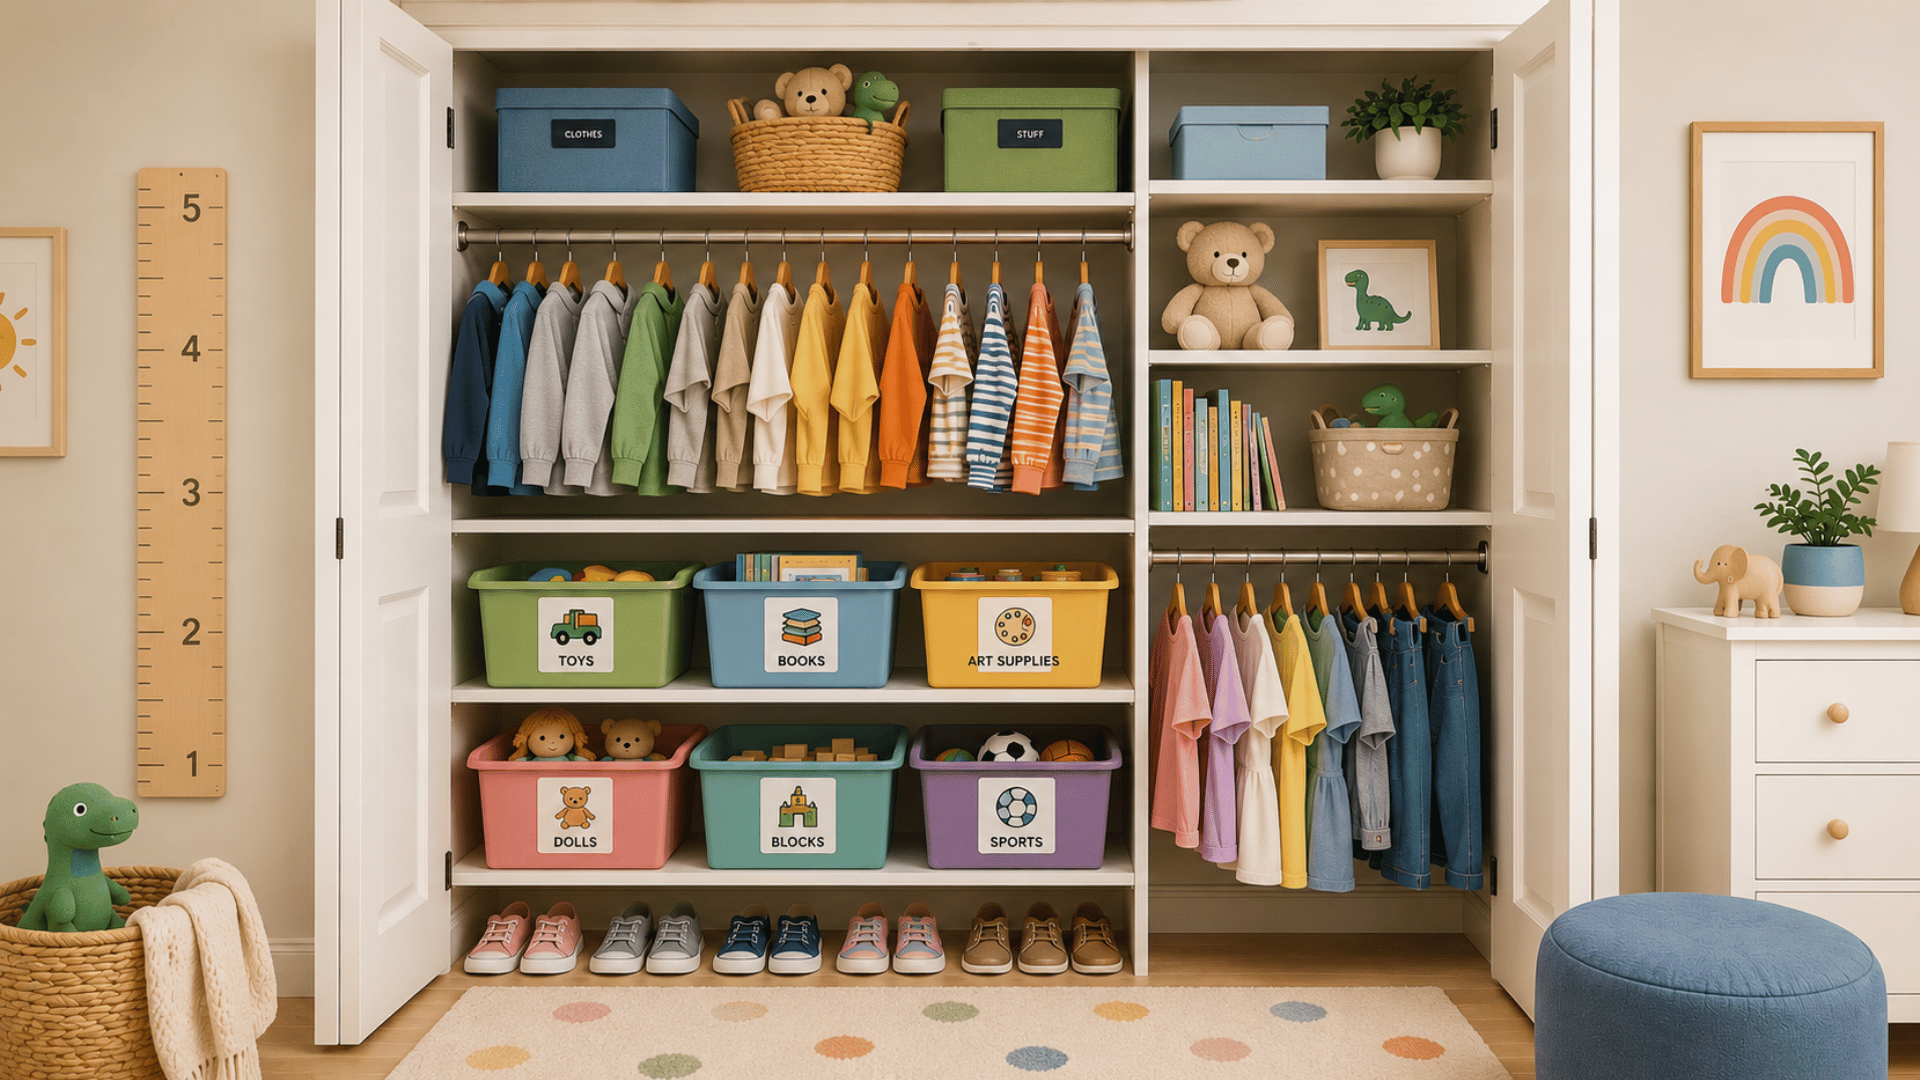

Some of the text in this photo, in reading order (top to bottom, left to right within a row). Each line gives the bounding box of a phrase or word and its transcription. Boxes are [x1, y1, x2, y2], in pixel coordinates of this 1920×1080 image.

[563, 129, 603, 140] CLOTHES
[1016, 129, 1044, 140] STUFF
[182, 193, 201, 222] 5
[181, 334, 201, 362] 4
[182, 477, 201, 507] 3
[182, 617, 201, 646] 2
[558, 655, 595, 667] TOYS
[778, 655, 826, 667] BOOKS
[967, 655, 1060, 667] ART SUPPLIES
[186, 750, 198, 778] 1
[553, 836, 598, 848] DOLLS
[771, 836, 825, 848] BLOCKS
[990, 836, 1044, 848] SPORTS
